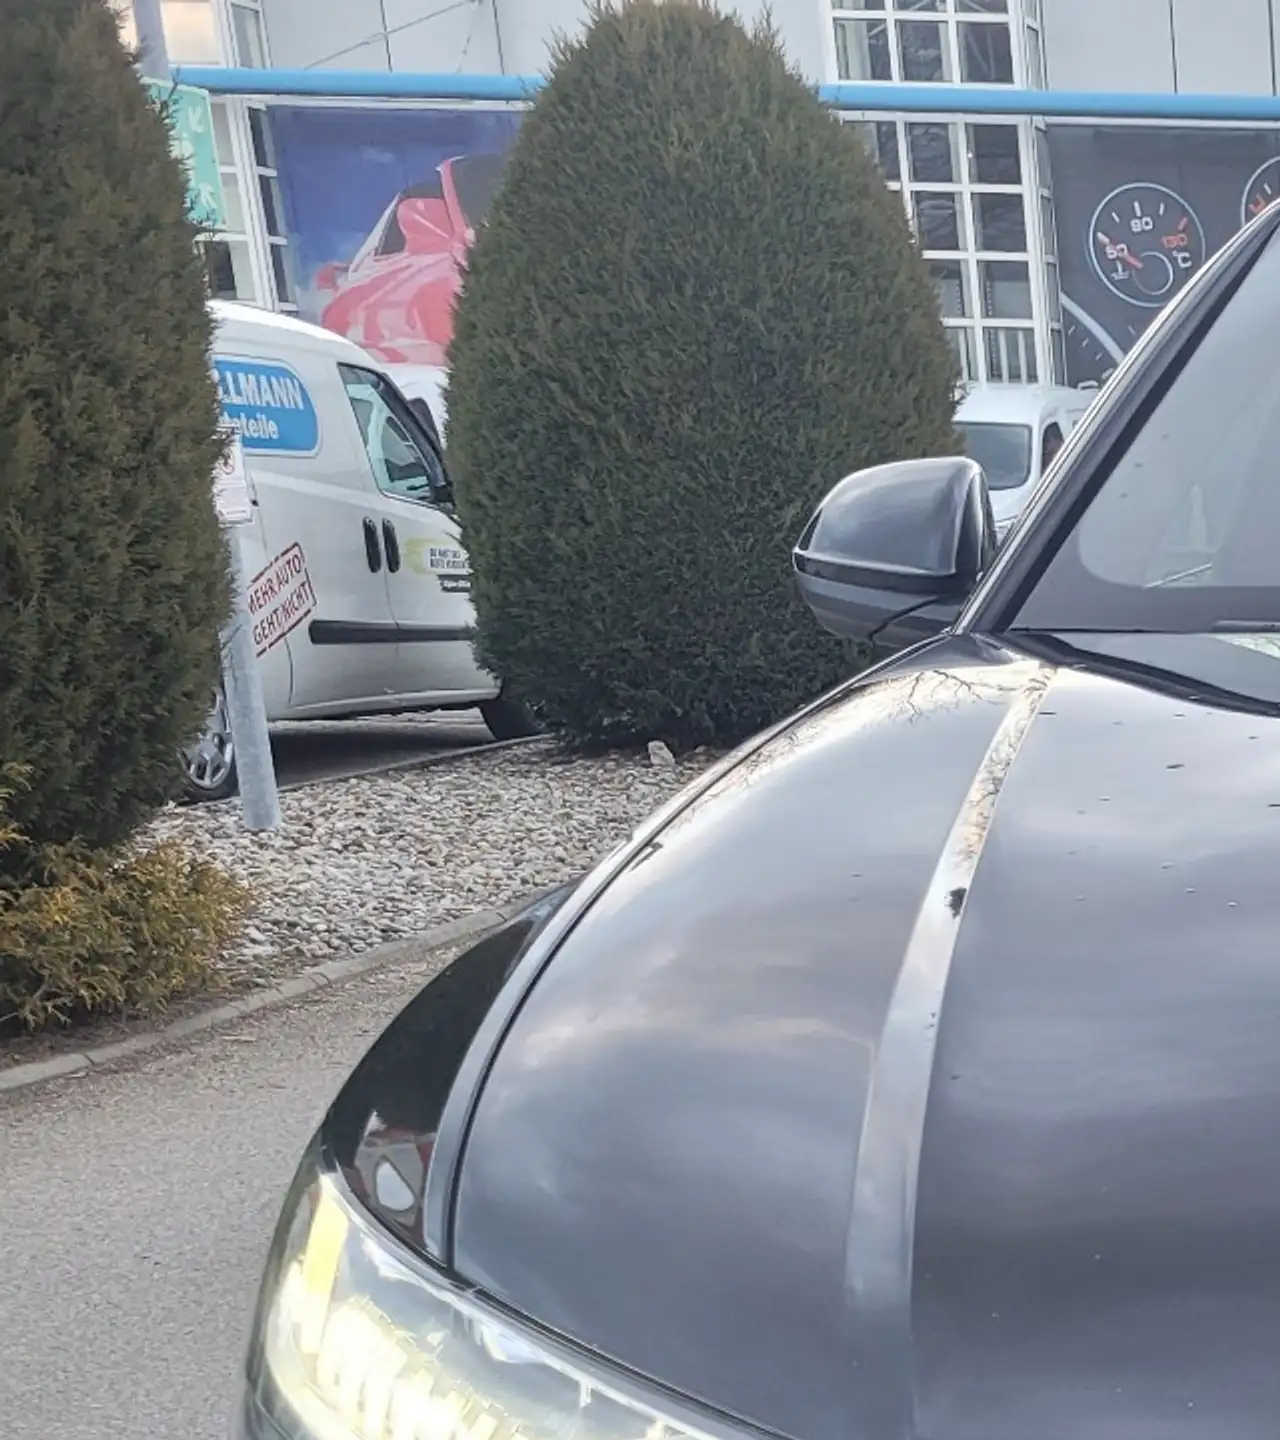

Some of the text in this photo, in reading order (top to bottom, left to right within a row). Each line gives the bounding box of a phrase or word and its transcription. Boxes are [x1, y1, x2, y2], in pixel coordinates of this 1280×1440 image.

[211, 368, 304, 411] LLMANN
[275, 553, 302, 589] AUTO
[252, 580, 310, 646] GEHT NICHT
